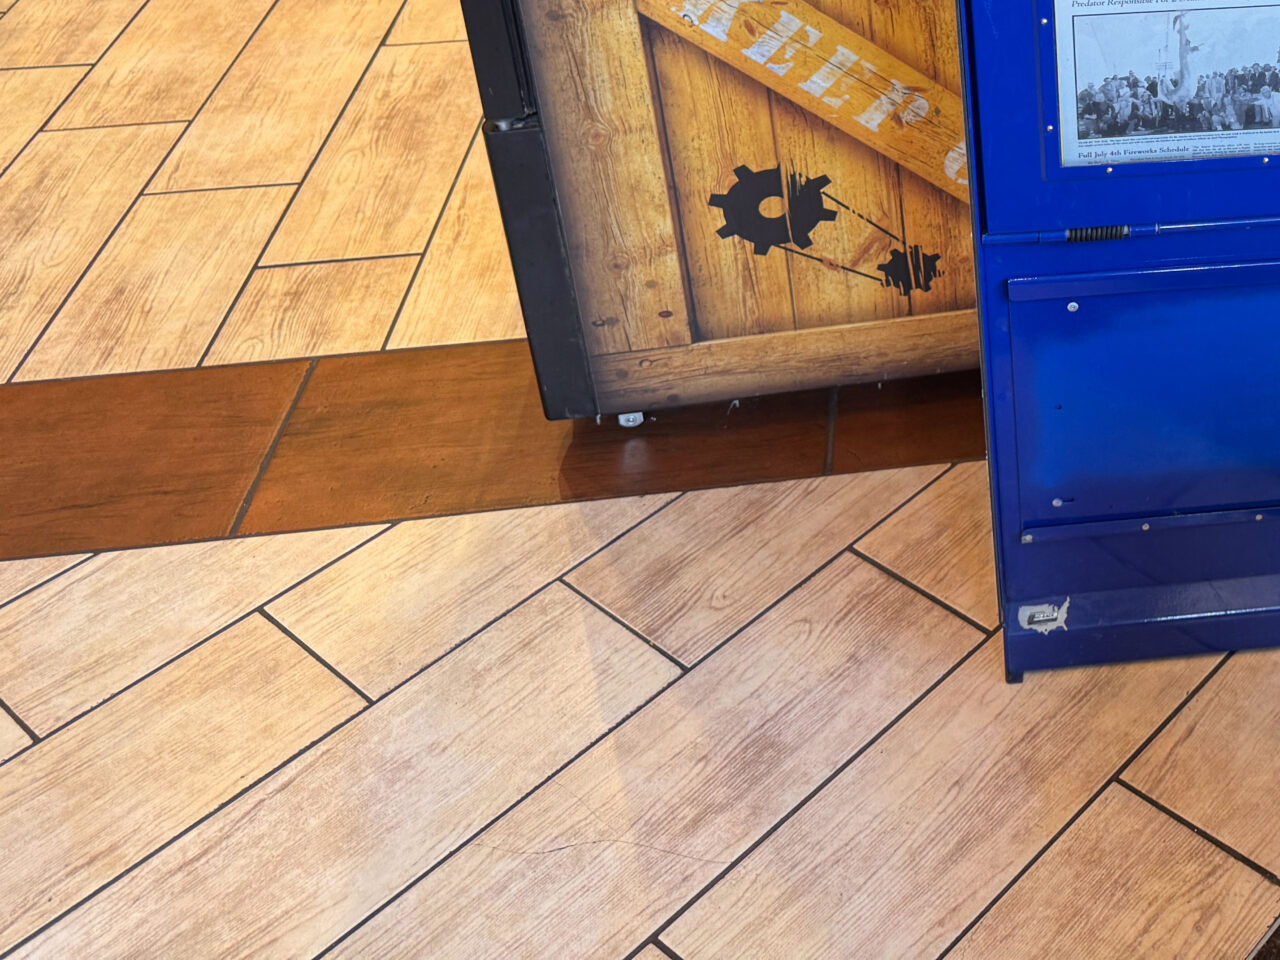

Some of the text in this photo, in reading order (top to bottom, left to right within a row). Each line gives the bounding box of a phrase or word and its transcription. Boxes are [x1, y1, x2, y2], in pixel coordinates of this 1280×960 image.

[1071, 0, 1105, 8] Predator
[1078, 151, 1093, 159] Full
[1095, 151, 1107, 159] July
[1109, 148, 1122, 157] 4th
[1123, 147, 1158, 156] Fireworks
[1159, 145, 1190, 154] Schedule
